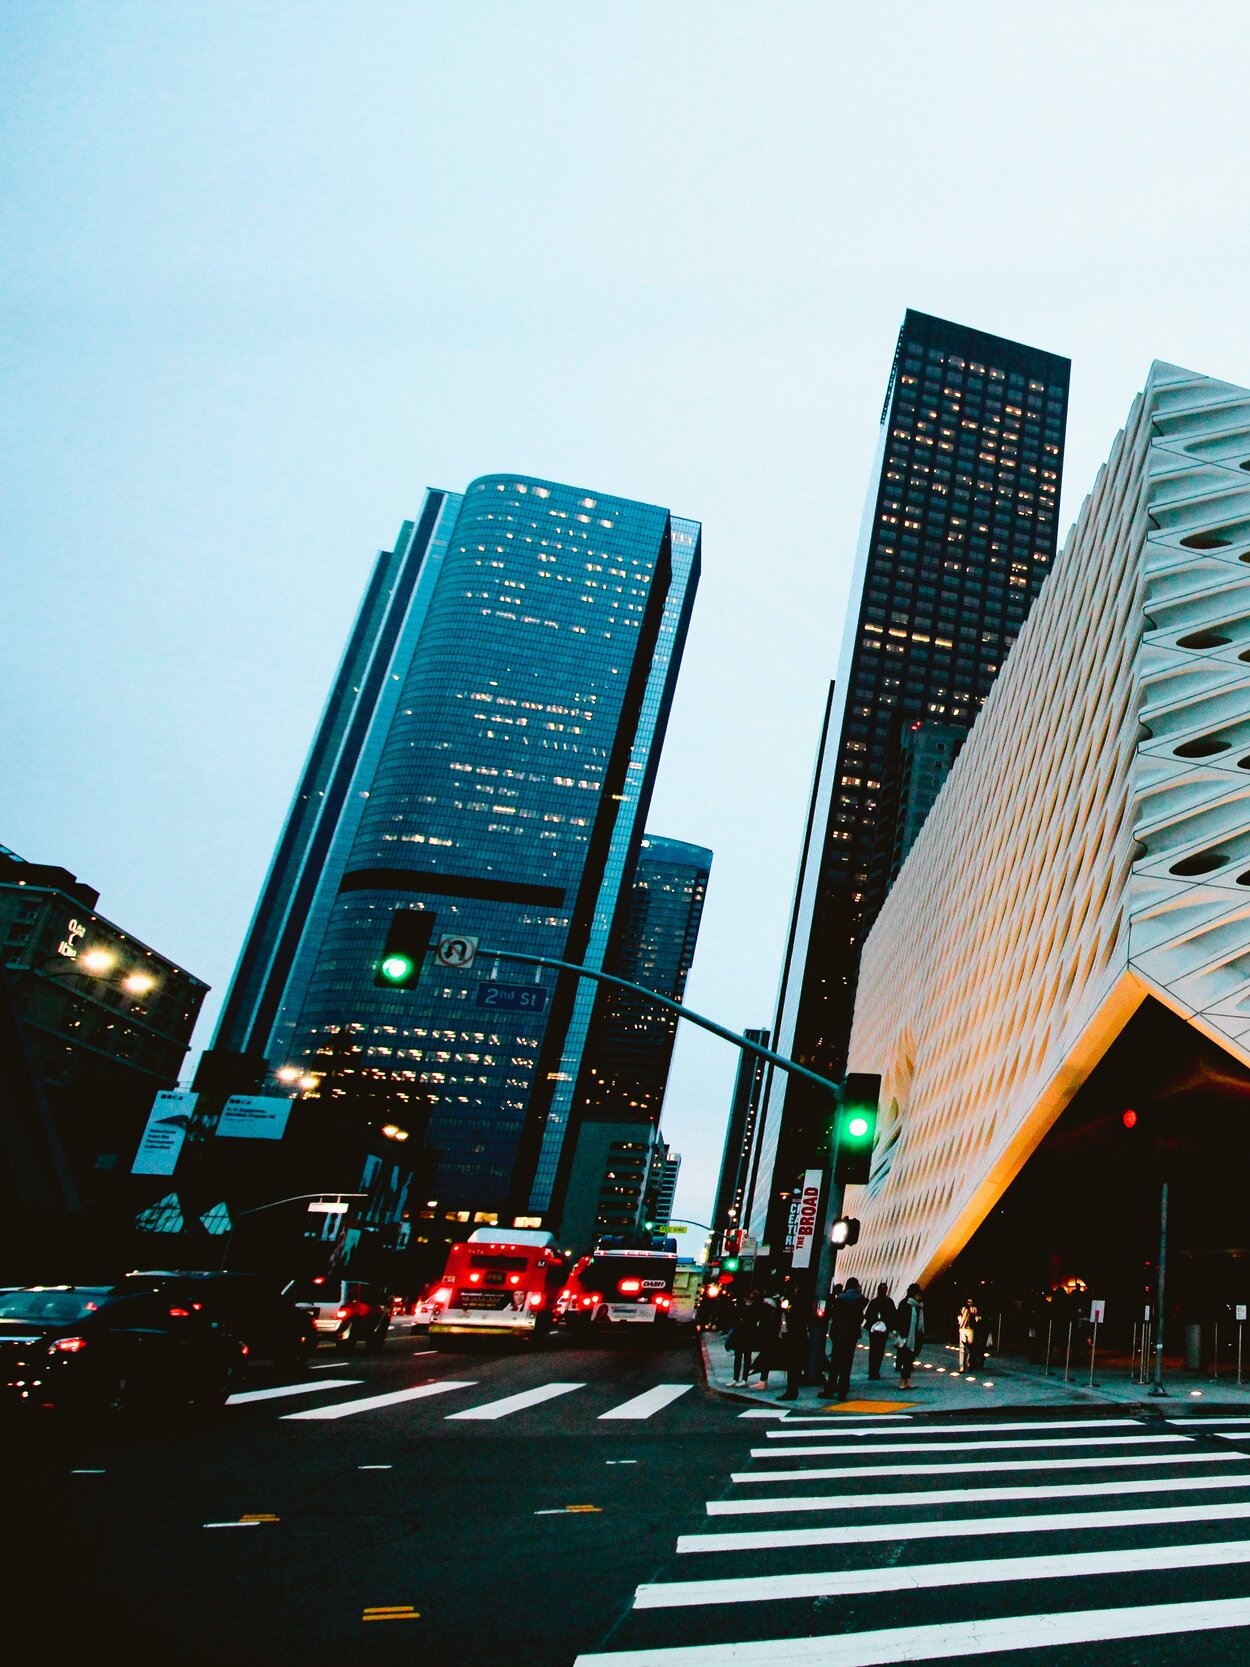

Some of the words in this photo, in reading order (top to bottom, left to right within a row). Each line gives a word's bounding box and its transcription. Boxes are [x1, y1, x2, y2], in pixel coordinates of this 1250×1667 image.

[484, 988, 515, 1005] 2nd
[519, 992, 537, 1006] St
[798, 1187, 818, 1235] BROAD
[796, 1236, 805, 1249] THE
